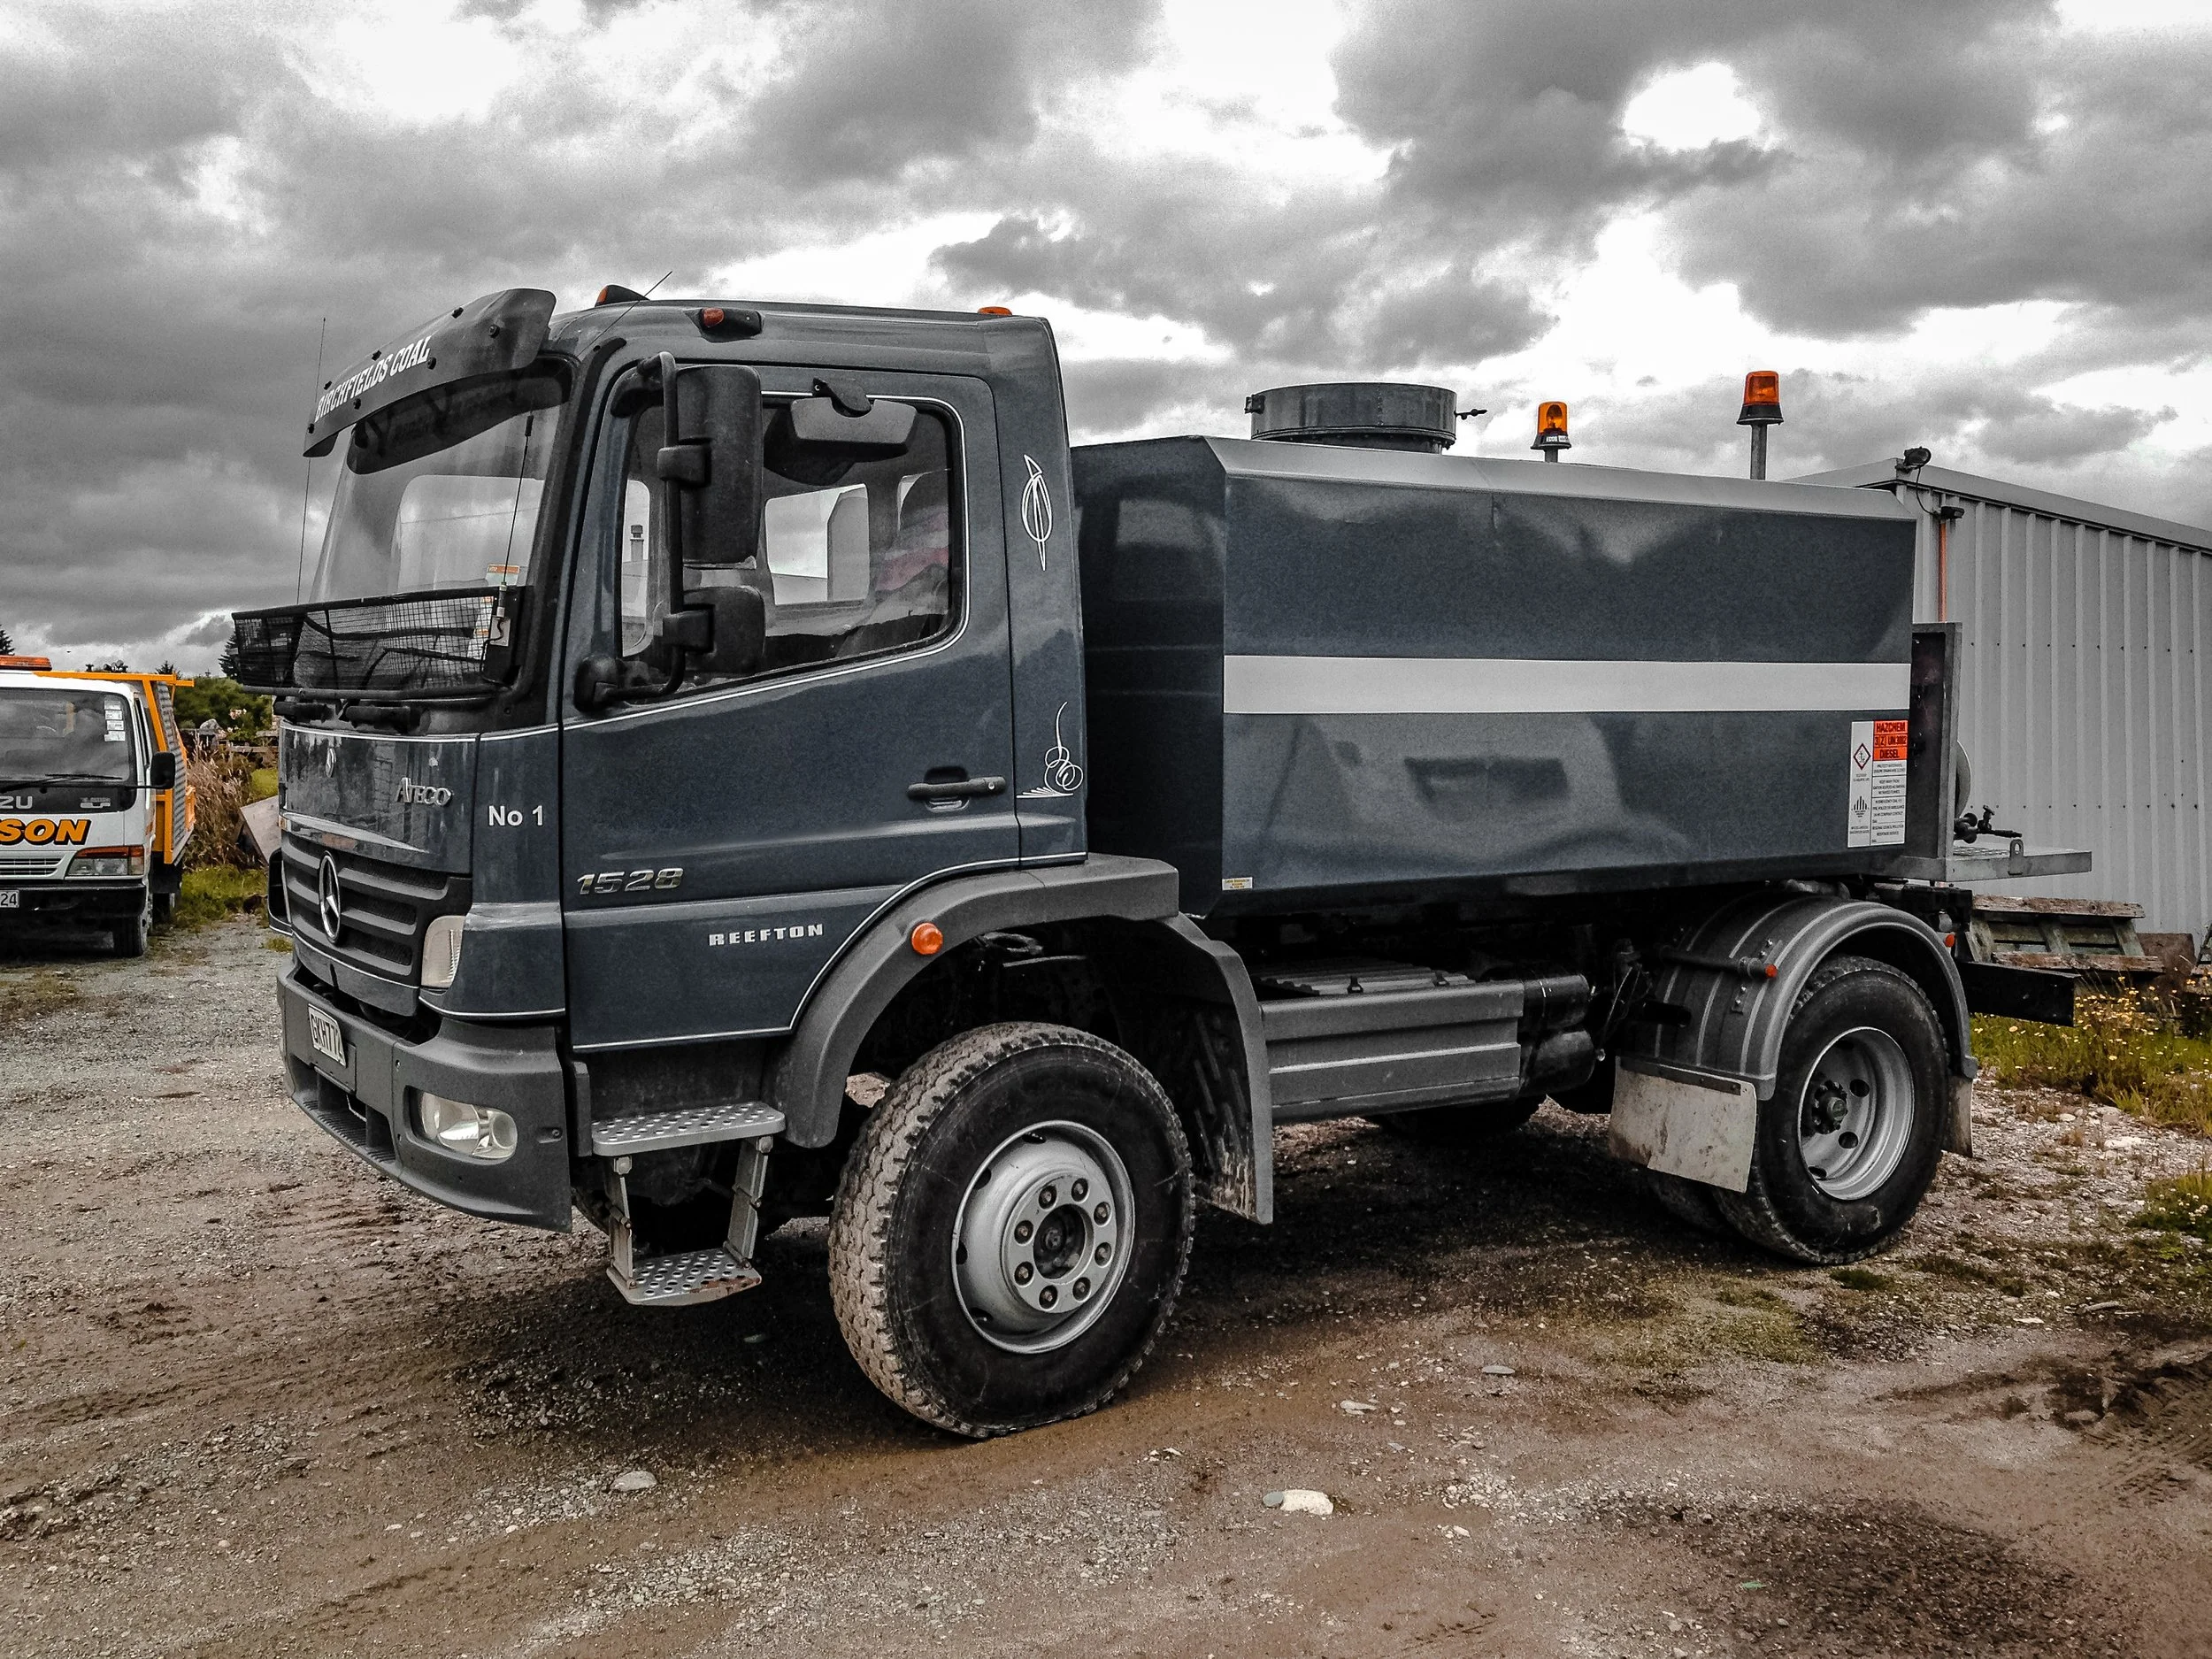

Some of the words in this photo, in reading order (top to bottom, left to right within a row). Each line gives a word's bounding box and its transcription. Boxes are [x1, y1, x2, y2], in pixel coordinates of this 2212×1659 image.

[314, 354, 393, 423] BIRCHFIELDS
[389, 335, 431, 376] COAL
[1876, 722, 1906, 733] HAZCHEM
[1879, 749, 1900, 758] DIESEL
[488, 806, 523, 826] No
[532, 806, 544, 826] 1
[577, 867, 684, 895] 1528
[709, 924, 824, 947] REEFTON
